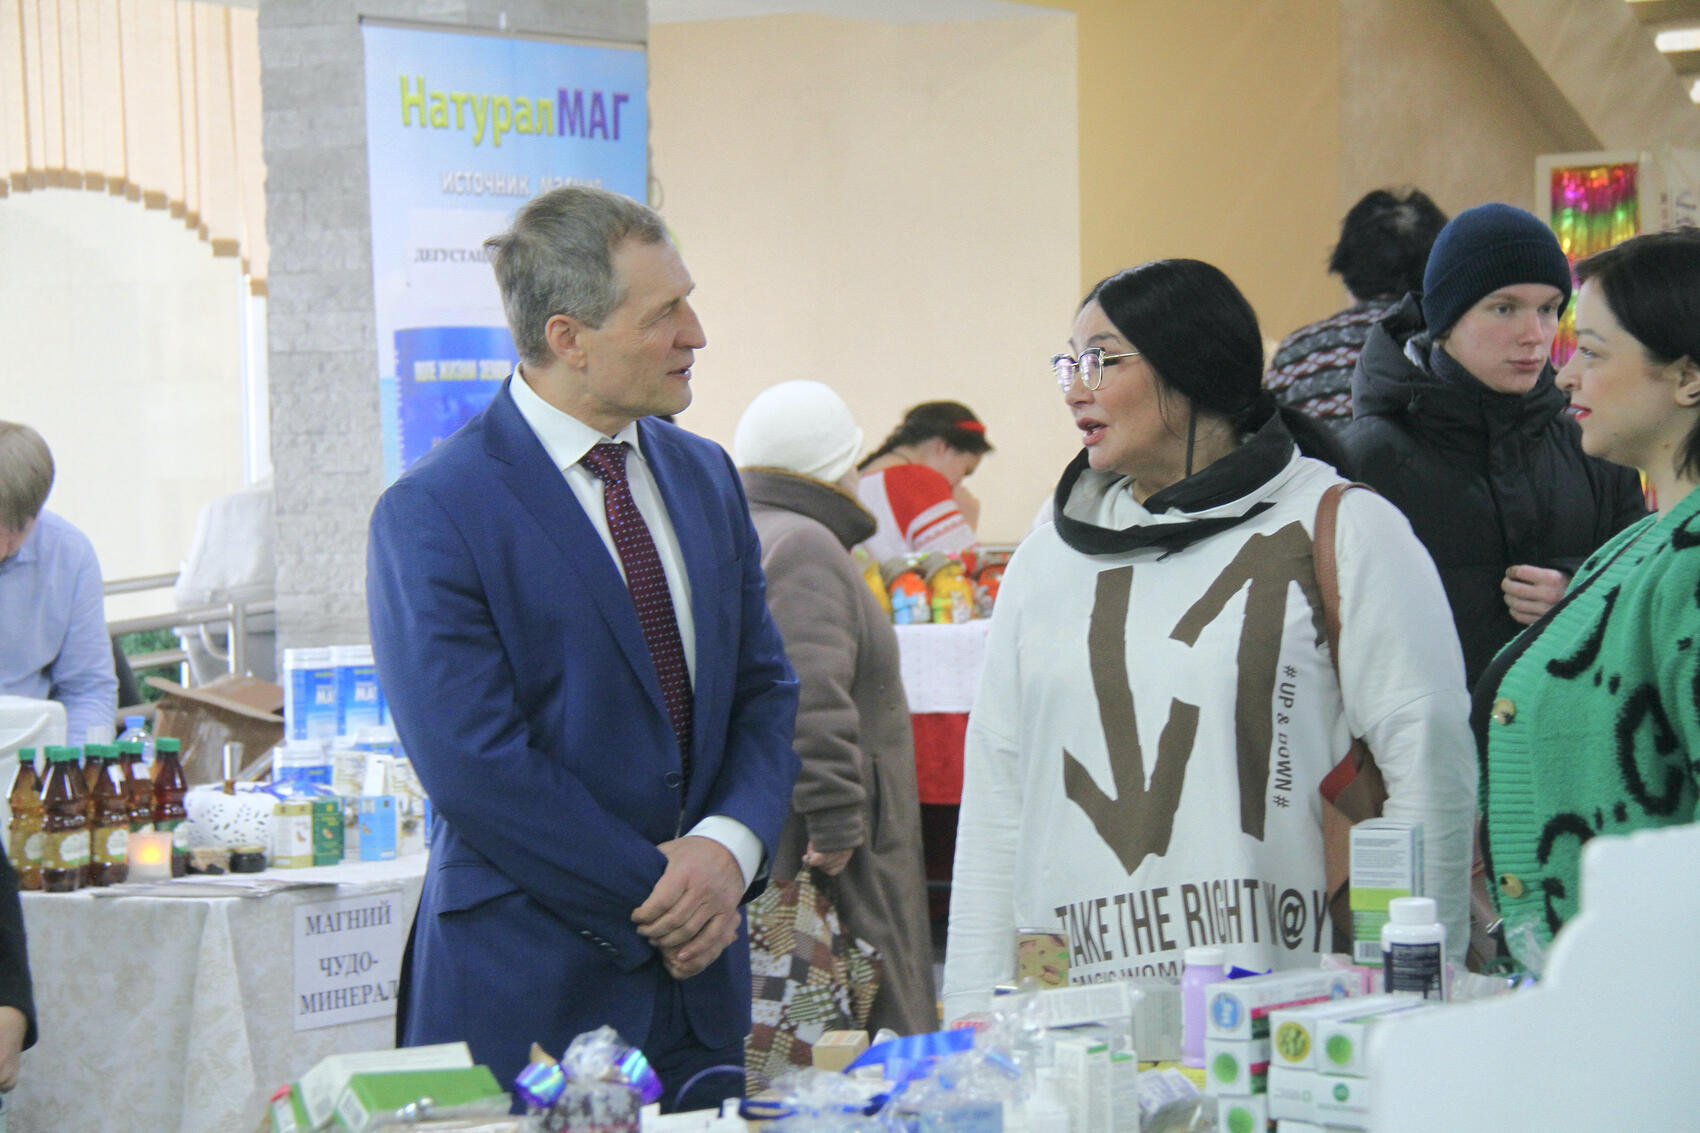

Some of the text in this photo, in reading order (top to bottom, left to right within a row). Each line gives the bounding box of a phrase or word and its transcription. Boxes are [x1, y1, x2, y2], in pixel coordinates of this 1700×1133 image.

[399, 75, 630, 147] НатуралМАГ
[305, 900, 392, 936] МАГНИЙ
[1054, 897, 1113, 968] TAKE
[1113, 887, 1176, 958] THE
[1181, 879, 1260, 947] RIGHT
[319, 951, 378, 977] ЧУДО-
